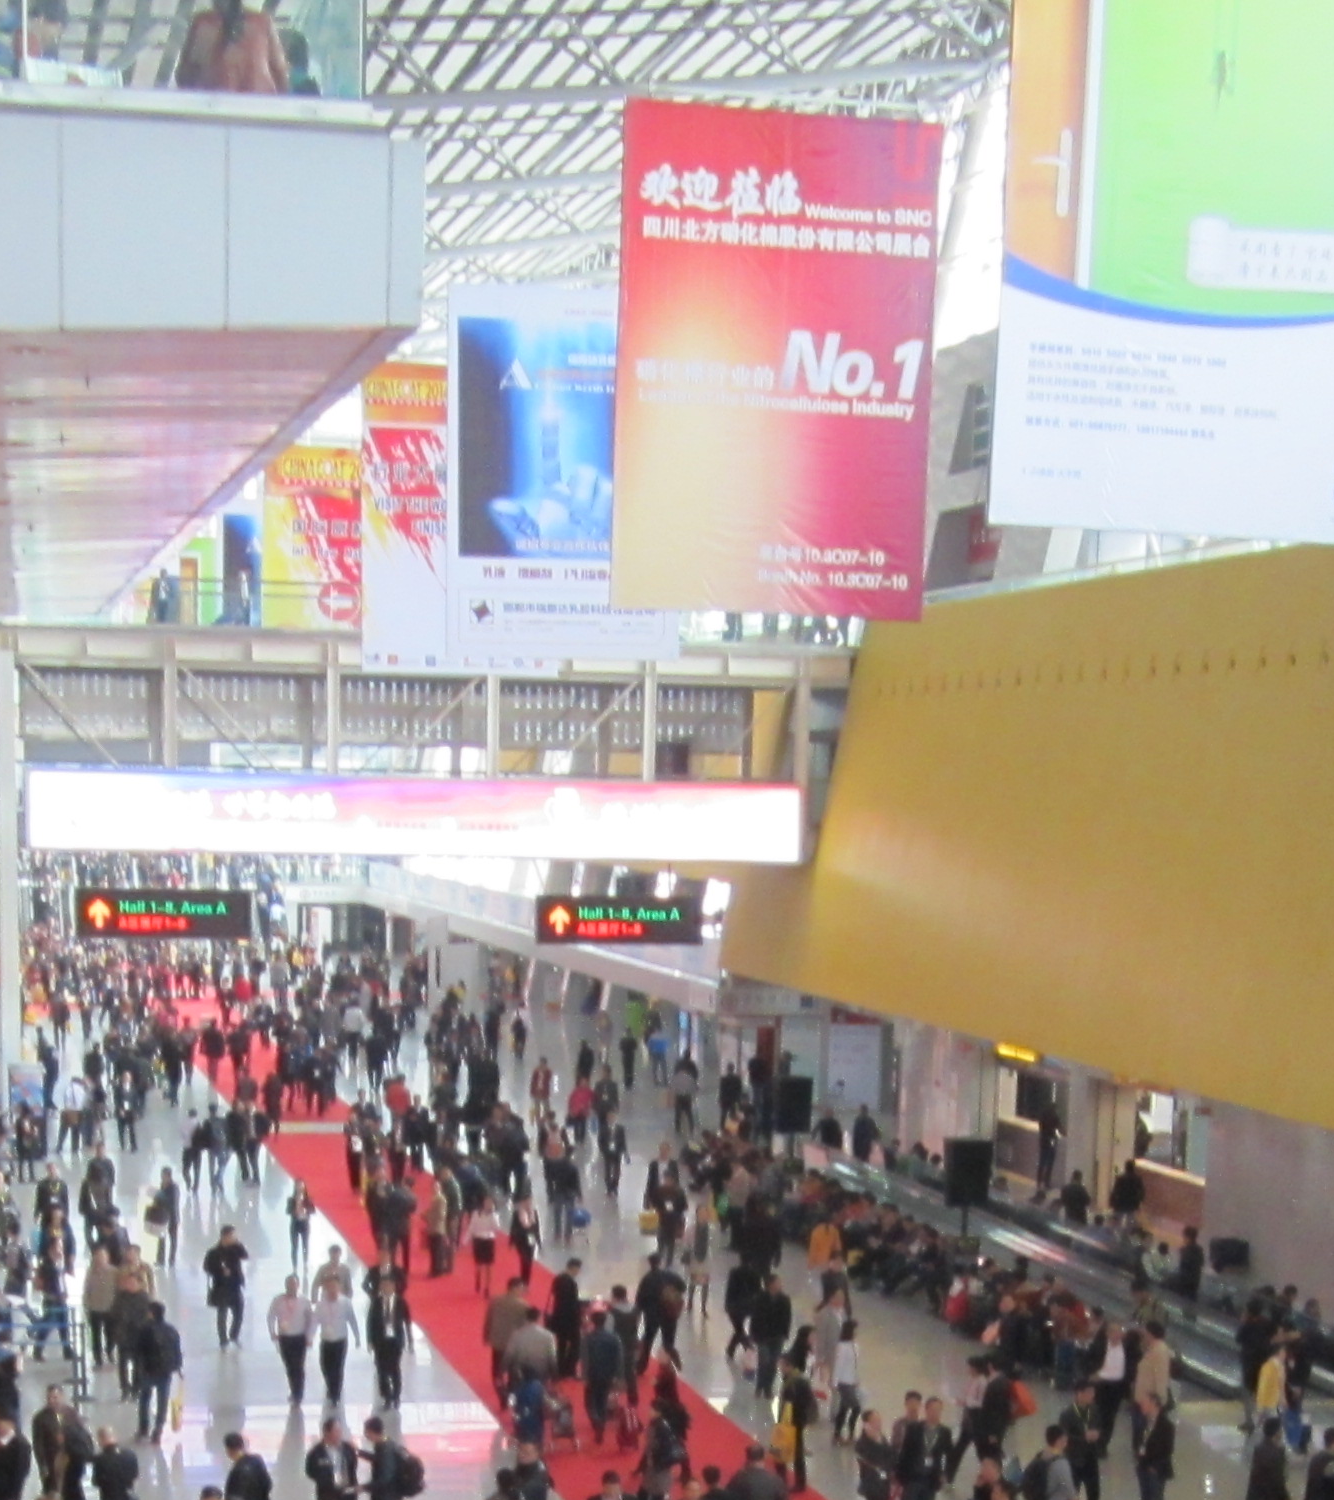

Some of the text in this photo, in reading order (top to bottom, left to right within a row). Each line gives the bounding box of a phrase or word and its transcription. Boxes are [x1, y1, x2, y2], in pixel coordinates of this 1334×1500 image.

[804, 202, 873, 223] Welcome
[876, 206, 891, 224] to
[779, 328, 925, 400] No.1
[852, 398, 915, 422] Industry
[119, 900, 146, 914] Hall
[181, 901, 212, 914] Area
[216, 901, 227, 915] A
[578, 906, 603, 920] Hall
[636, 907, 666, 921] Area
[670, 908, 680, 921] A
